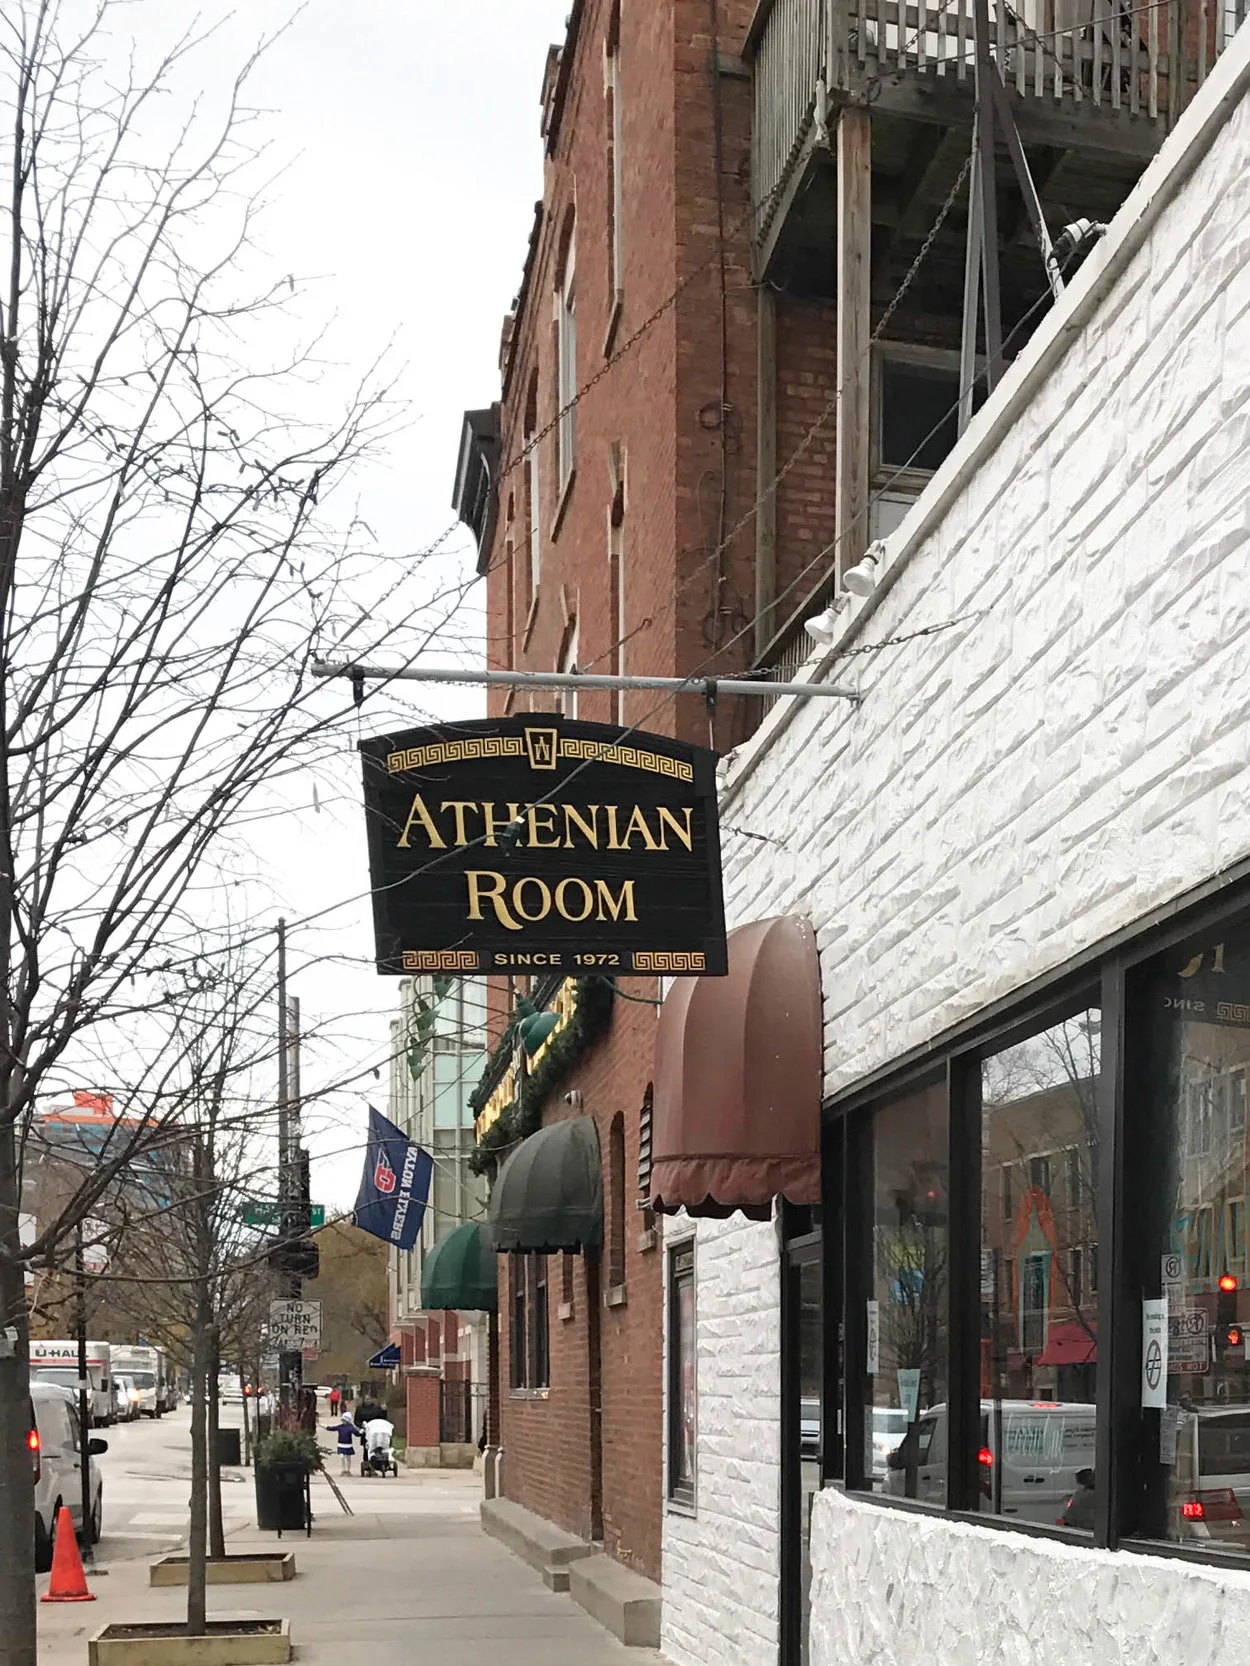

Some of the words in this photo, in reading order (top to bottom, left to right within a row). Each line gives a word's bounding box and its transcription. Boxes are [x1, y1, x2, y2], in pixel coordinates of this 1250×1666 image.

[397, 793, 693, 852] ATHENIAN
[464, 870, 638, 930] ROOM
[494, 953, 562, 966] SINCE
[573, 953, 621, 966] 1972
[286, 1303, 303, 1313] NO
[279, 1313, 311, 1324] TURN
